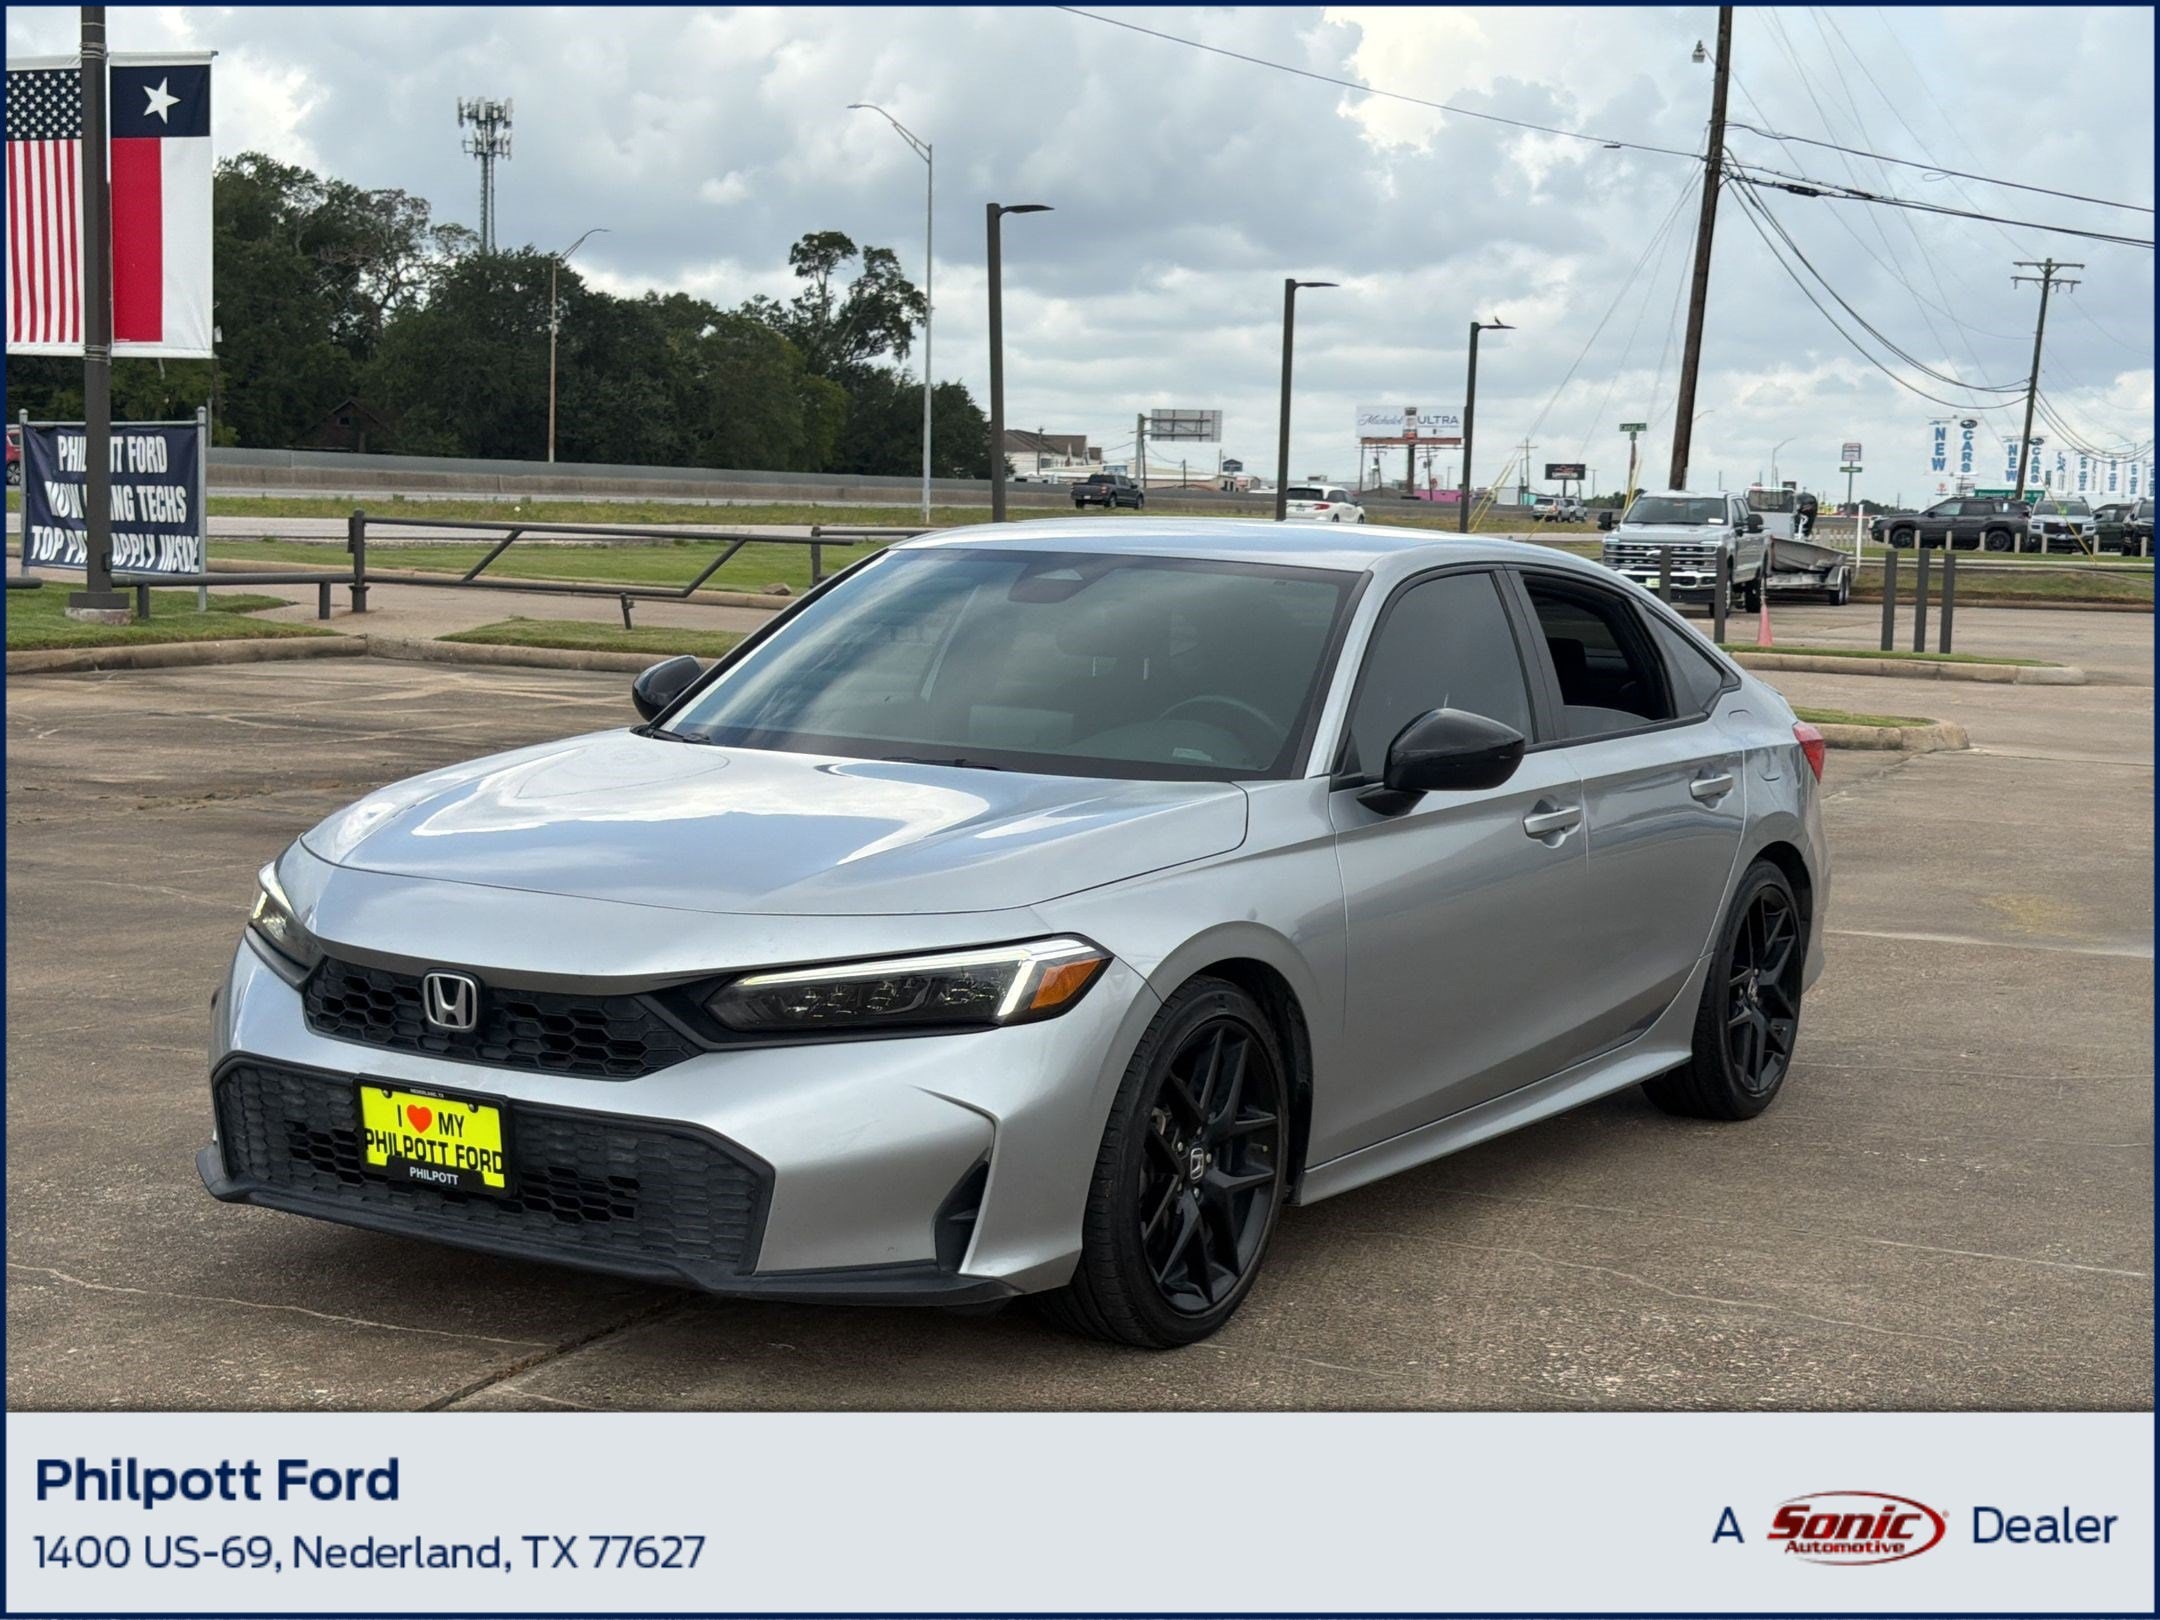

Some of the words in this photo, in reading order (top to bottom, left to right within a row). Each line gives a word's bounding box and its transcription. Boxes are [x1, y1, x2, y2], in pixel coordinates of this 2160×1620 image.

[1418, 415, 1460, 425] ULTRA
[127, 435, 168, 474] FORD
[1932, 427, 1946, 471] NEW
[1961, 430, 1974, 473] CARS
[2030, 447, 2042, 483] CARS
[136, 484, 187, 524] TECHS
[31, 525, 64, 561] TOP
[157, 534, 200, 573] INSIDE
[397, 1104, 403, 1128] I
[438, 1112, 465, 1138] MY
[364, 1128, 448, 1166] PHILPOTT
[455, 1144, 504, 1175] FORD
[409, 1166, 459, 1186] PHILPOTT
